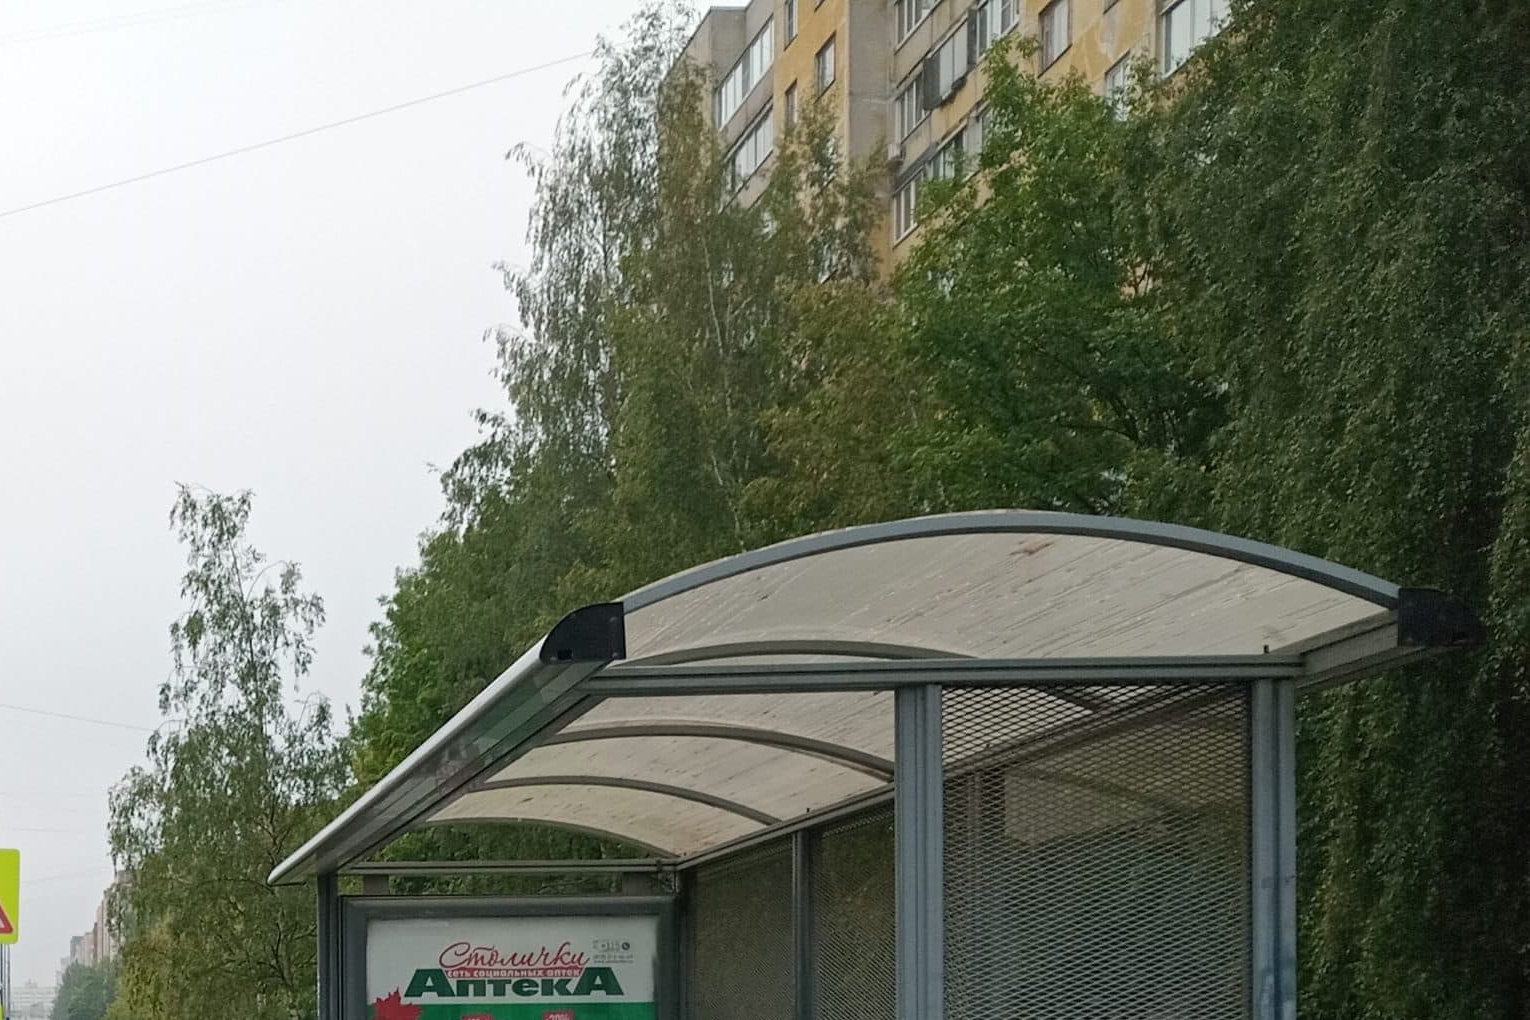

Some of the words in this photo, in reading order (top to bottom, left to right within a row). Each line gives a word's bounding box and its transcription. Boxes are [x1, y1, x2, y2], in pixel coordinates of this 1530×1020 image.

[438, 941, 590, 969] Столички
[447, 969, 470, 977] сеть
[473, 969, 544, 978] социальных
[546, 969, 581, 977] аптек
